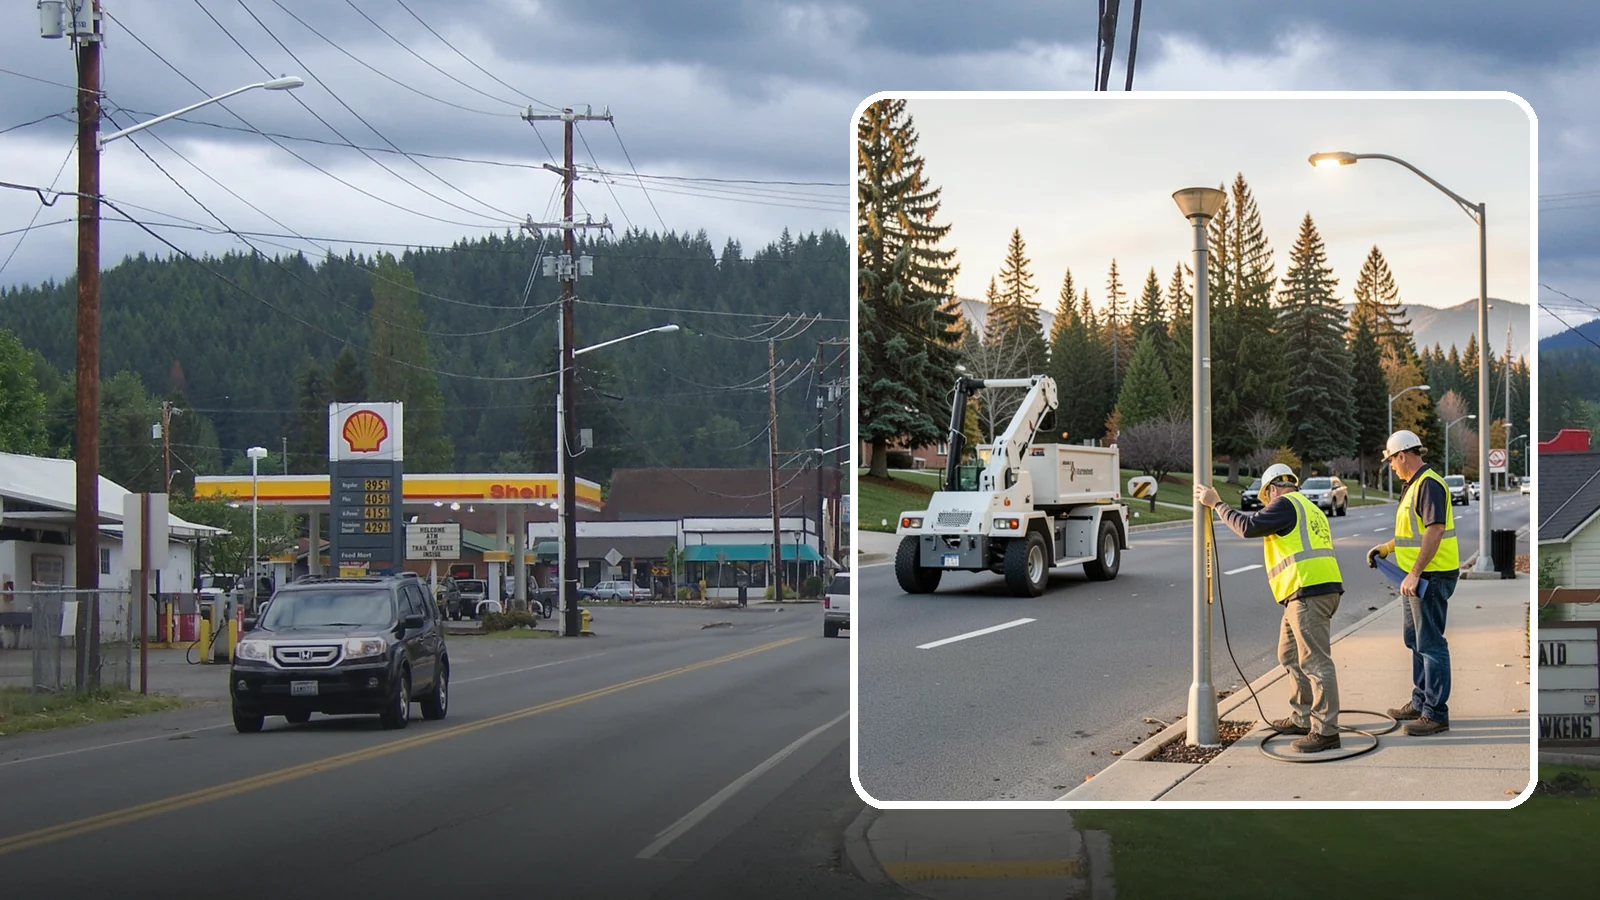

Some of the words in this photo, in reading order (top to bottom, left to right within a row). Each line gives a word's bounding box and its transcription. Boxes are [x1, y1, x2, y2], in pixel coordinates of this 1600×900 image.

[365, 480, 384, 490] 395
[490, 484, 547, 499] Shell
[365, 494, 384, 504] 405
[365, 508, 384, 518] 415
[365, 522, 384, 533] 429
